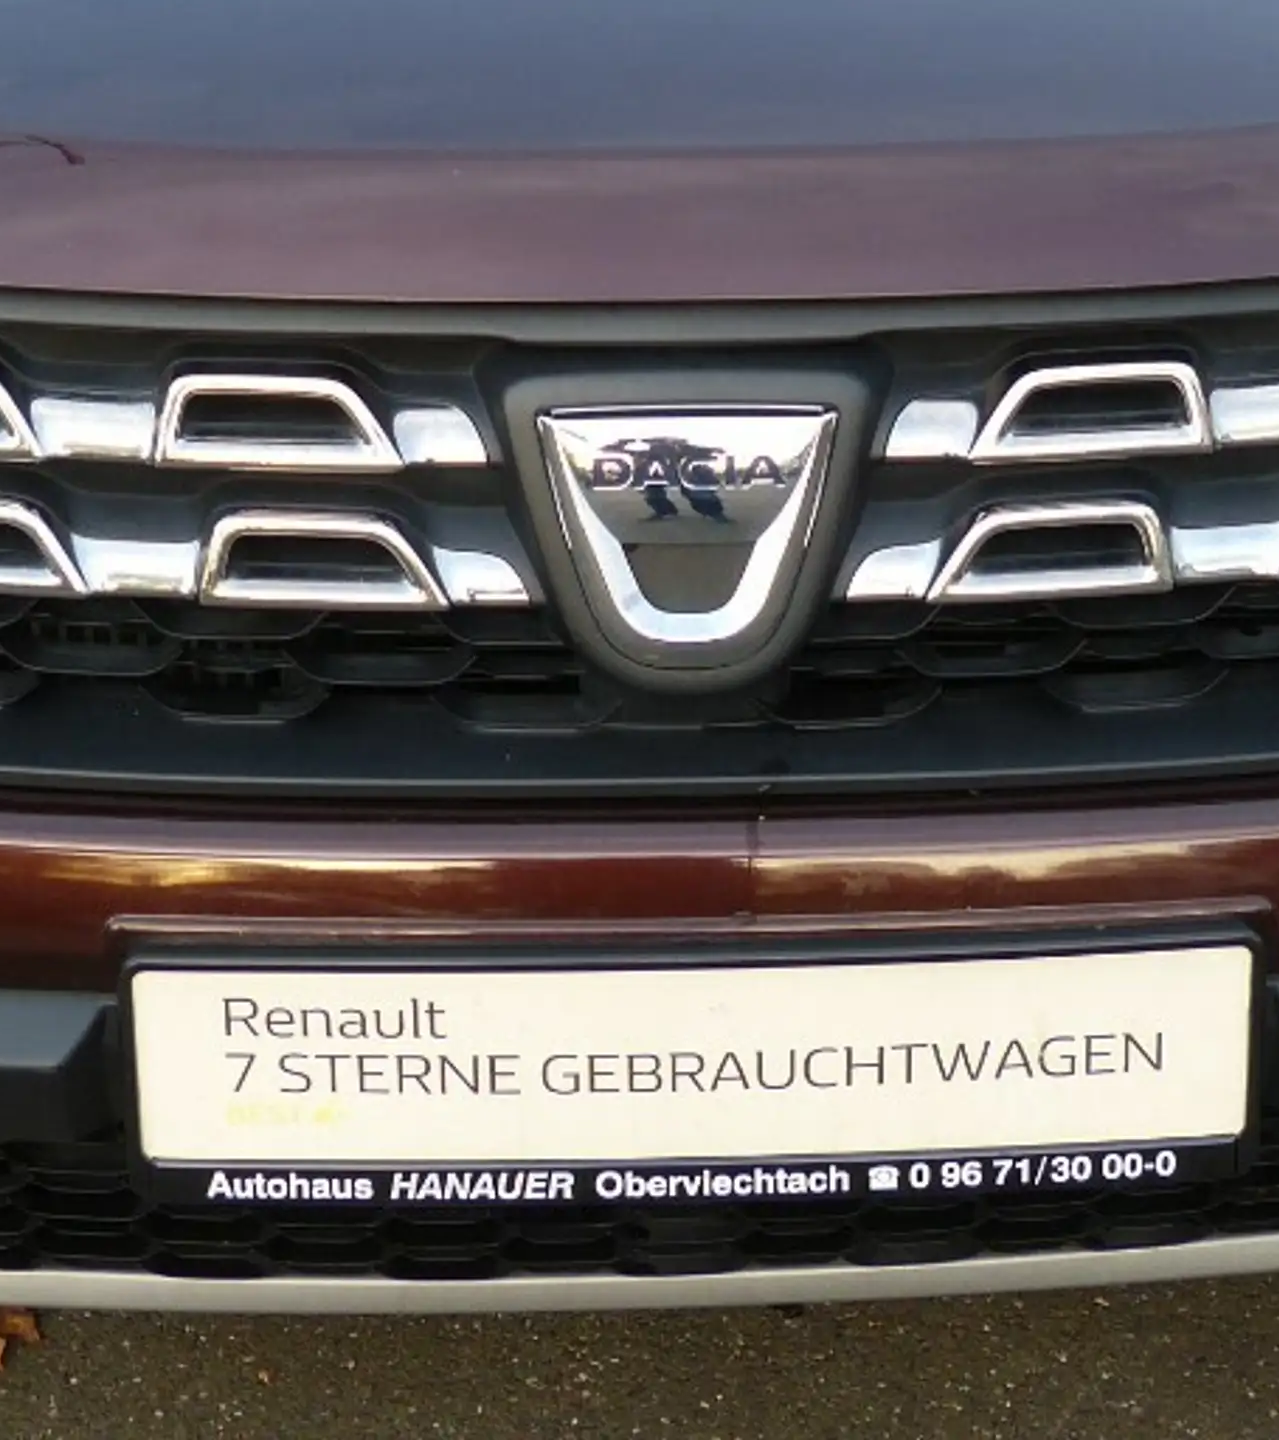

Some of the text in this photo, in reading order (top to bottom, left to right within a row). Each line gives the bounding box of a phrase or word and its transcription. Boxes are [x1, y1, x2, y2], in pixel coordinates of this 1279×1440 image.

[591, 455, 787, 491] DACIA
[223, 998, 447, 1039] Renault
[227, 1032, 1163, 1095] 7 STERNE GEBRAUCHTWAGEN
[206, 1170, 375, 1201] Autohaus
[390, 1171, 575, 1200] HANAUER
[909, 1162, 931, 1189] 0
[940, 1160, 983, 1188] 96
[992, 1155, 1093, 1186] 71/30
[1102, 1150, 1177, 1180] 00-0
